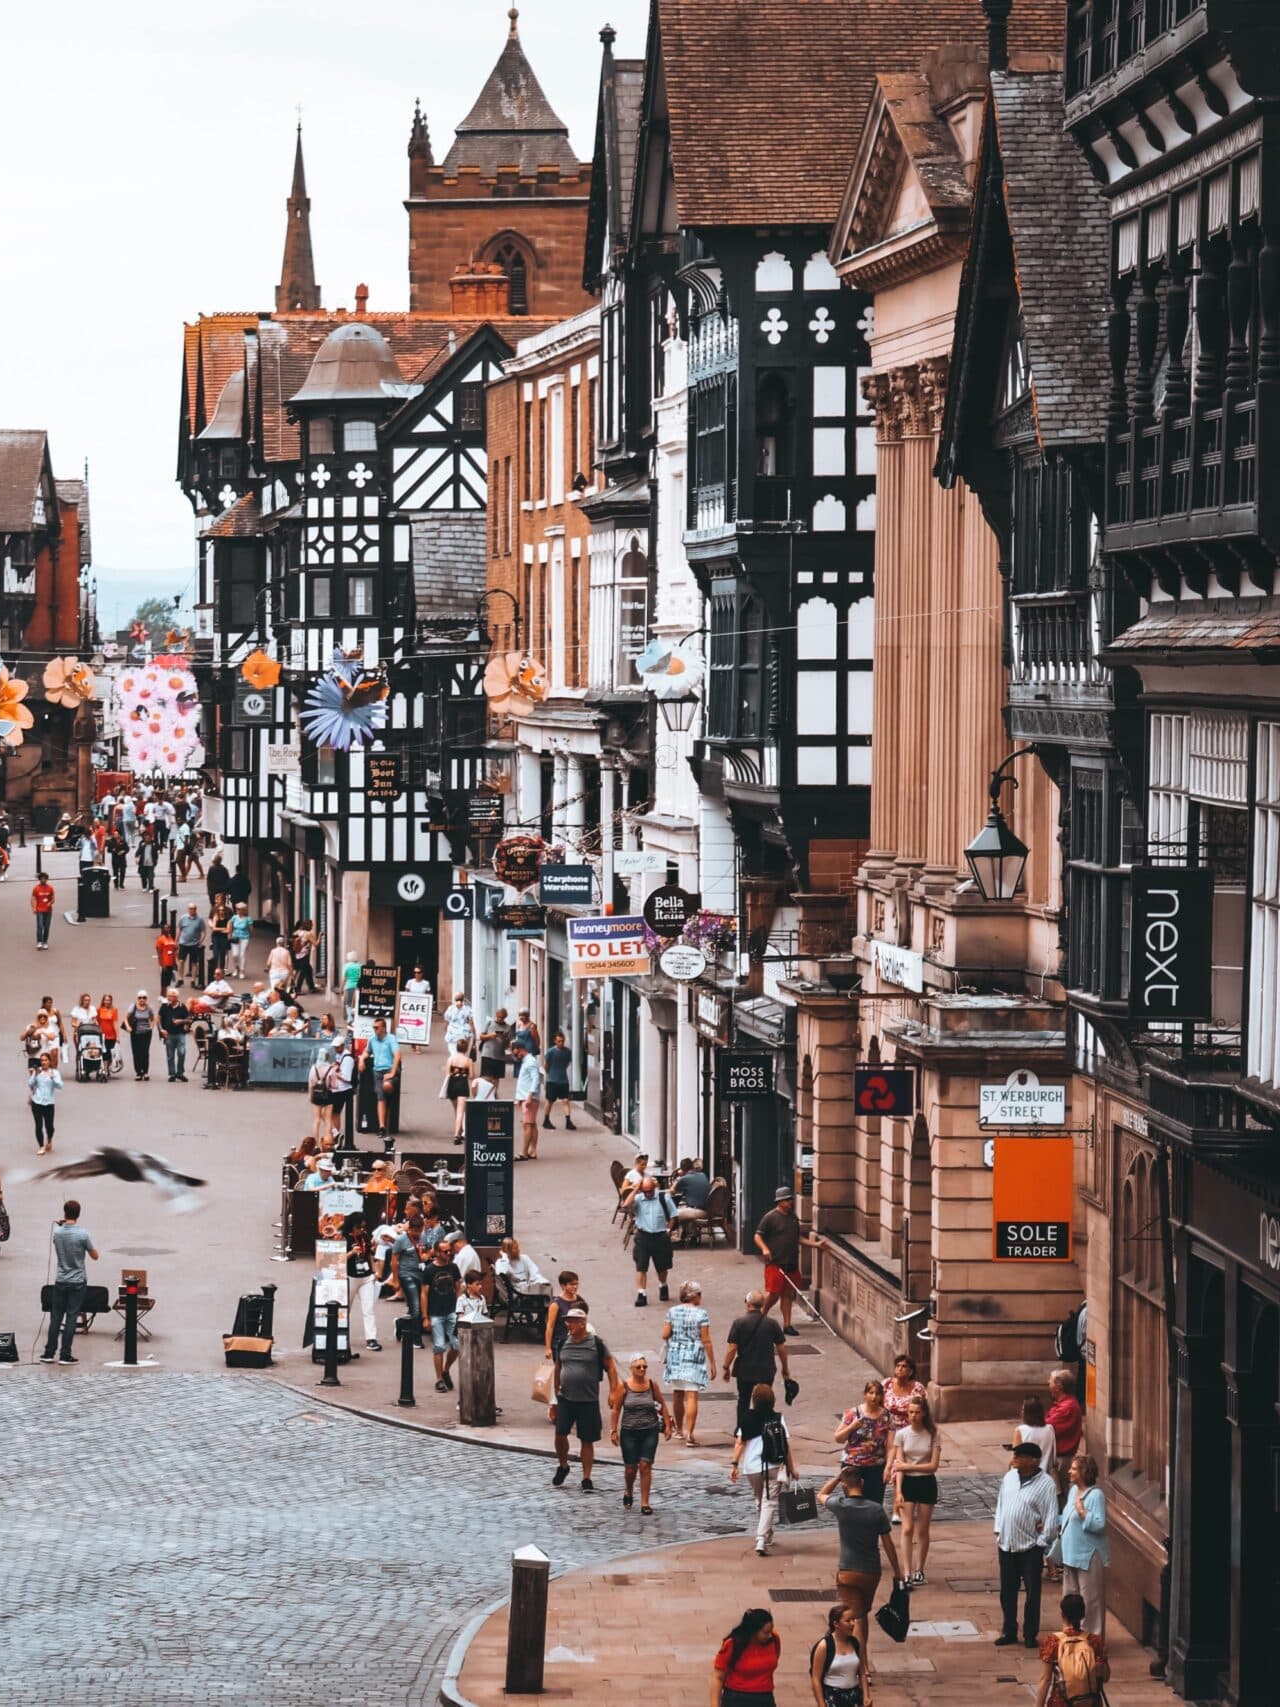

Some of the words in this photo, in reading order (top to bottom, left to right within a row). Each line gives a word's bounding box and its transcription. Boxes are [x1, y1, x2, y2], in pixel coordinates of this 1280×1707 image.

[549, 876, 588, 884] Carphone
[654, 896, 684, 908] Bella
[574, 922, 642, 936] kenneymoore
[574, 943, 600, 957] TO
[608, 941, 644, 956] LET
[1144, 888, 1180, 1007] next
[363, 968, 372, 976] THE
[374, 969, 396, 978] LEATHER
[402, 1002, 426, 1013] CAFE
[272, 1056, 316, 1069] NER
[730, 1067, 764, 1076] MOSS
[730, 1078, 767, 1088] BROS.
[982, 1090, 997, 1102] ST.
[1001, 1090, 1062, 1102] WERBURGH
[1000, 1106, 1044, 1118] STREET
[473, 1142, 486, 1150] The
[473, 1150, 506, 1162] Rows
[1008, 1226, 1058, 1240] SOLE
[1008, 1246, 1056, 1256] TRADER
